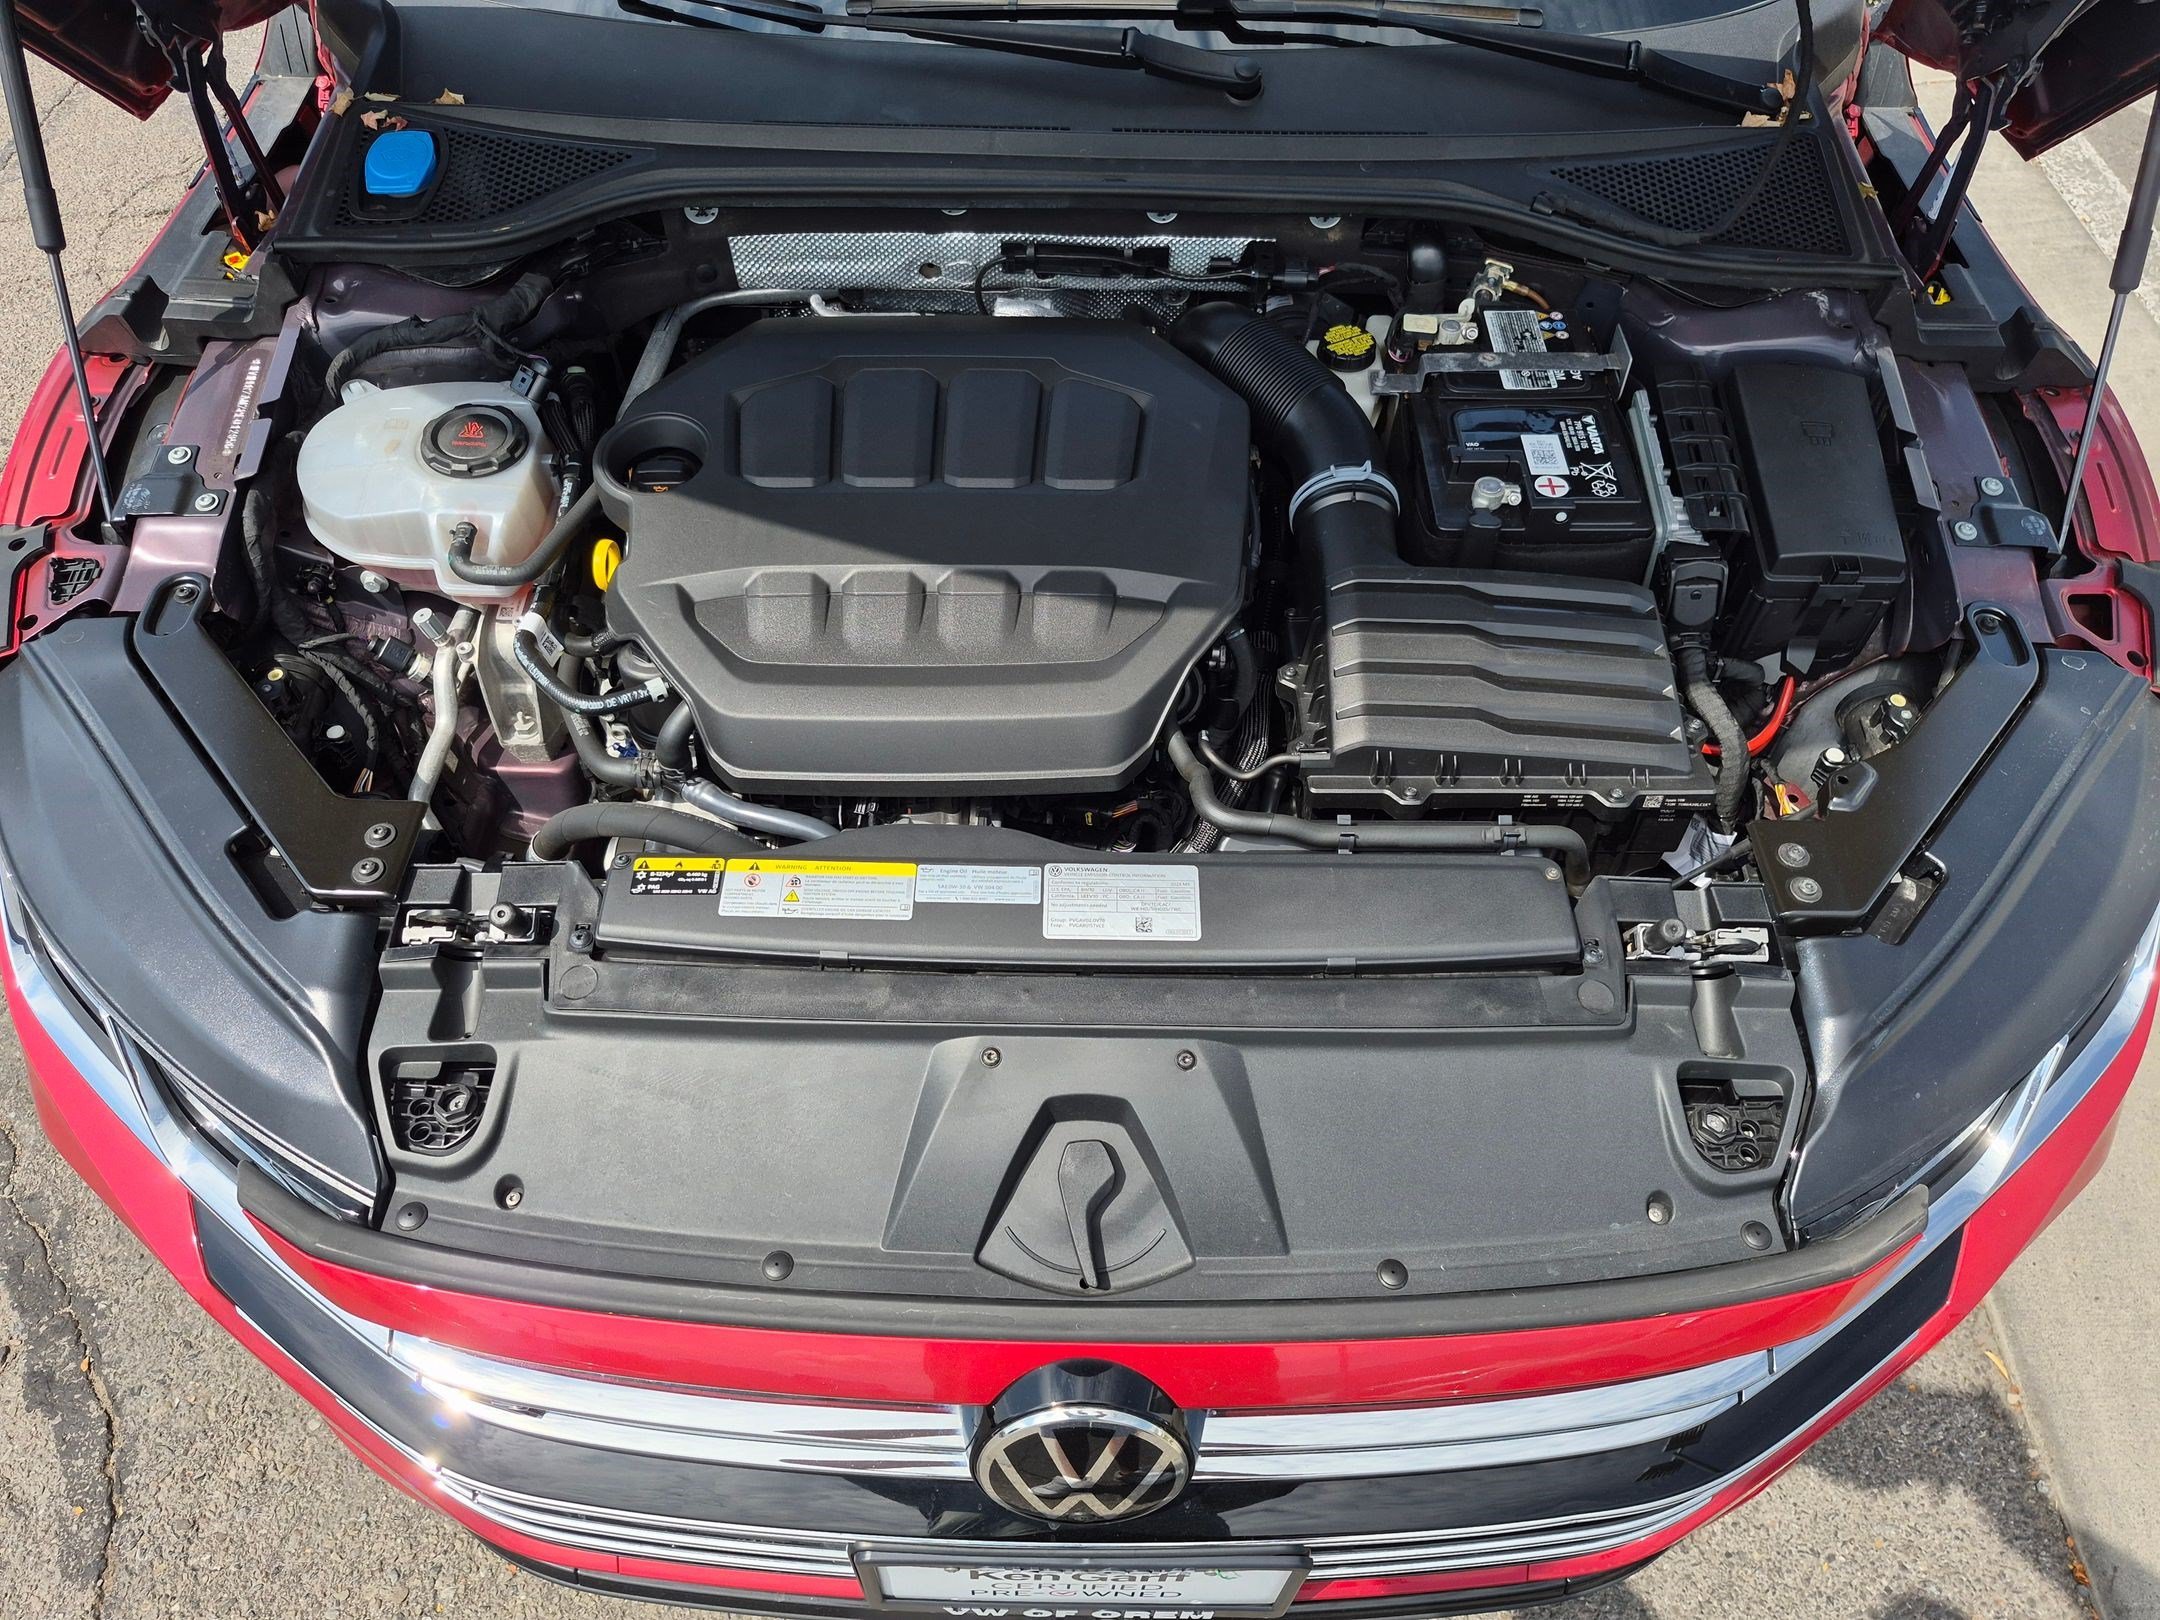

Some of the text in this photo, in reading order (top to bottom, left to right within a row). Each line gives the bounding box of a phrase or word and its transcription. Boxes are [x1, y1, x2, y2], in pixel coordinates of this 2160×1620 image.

[1586, 425, 1604, 454] VARTA
[968, 1569, 1192, 1583] Ken Garff
[990, 1582, 1164, 1592] CERTIFIED
[941, 1606, 1216, 1620] VW OF OREM
